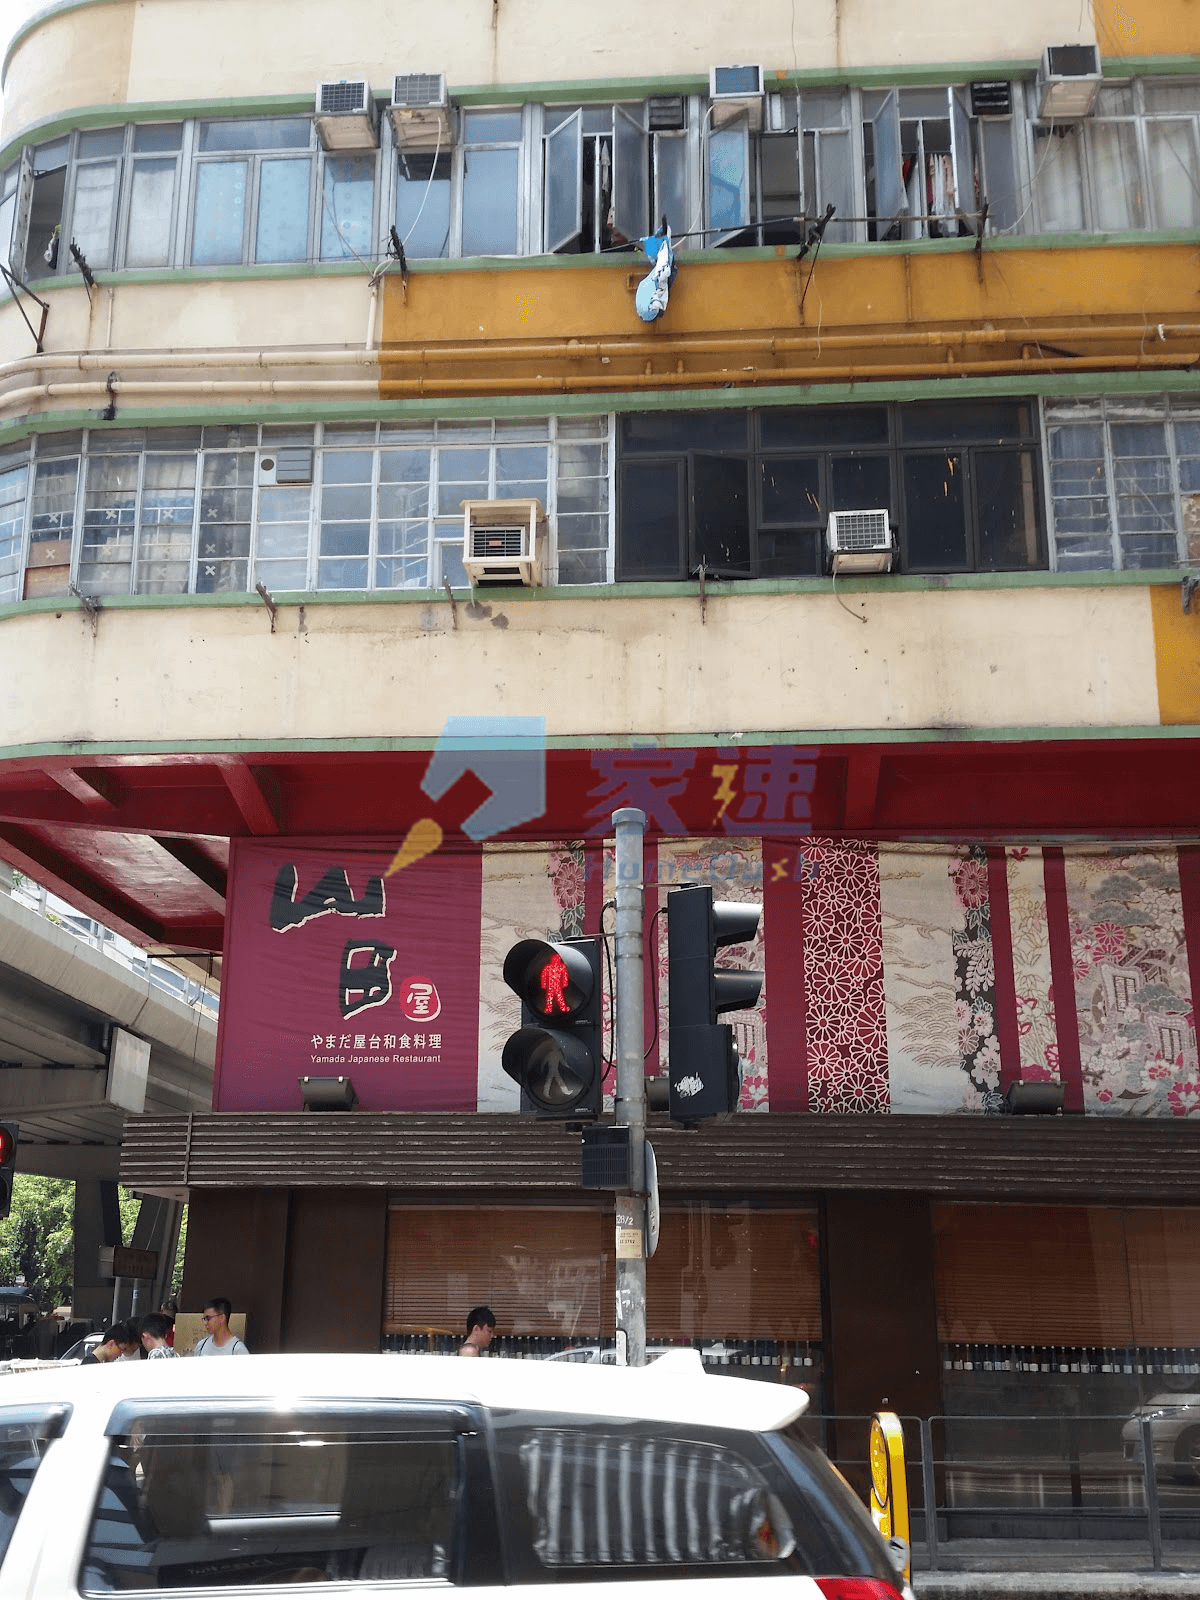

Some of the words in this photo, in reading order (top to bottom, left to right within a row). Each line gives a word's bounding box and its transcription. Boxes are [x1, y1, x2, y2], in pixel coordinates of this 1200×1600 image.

[311, 1034, 442, 1049] やまだ屋台和食料理
[311, 1054, 345, 1063] Yamada
[348, 1054, 390, 1065] Japanese
[393, 1054, 441, 1063] Restaurant
